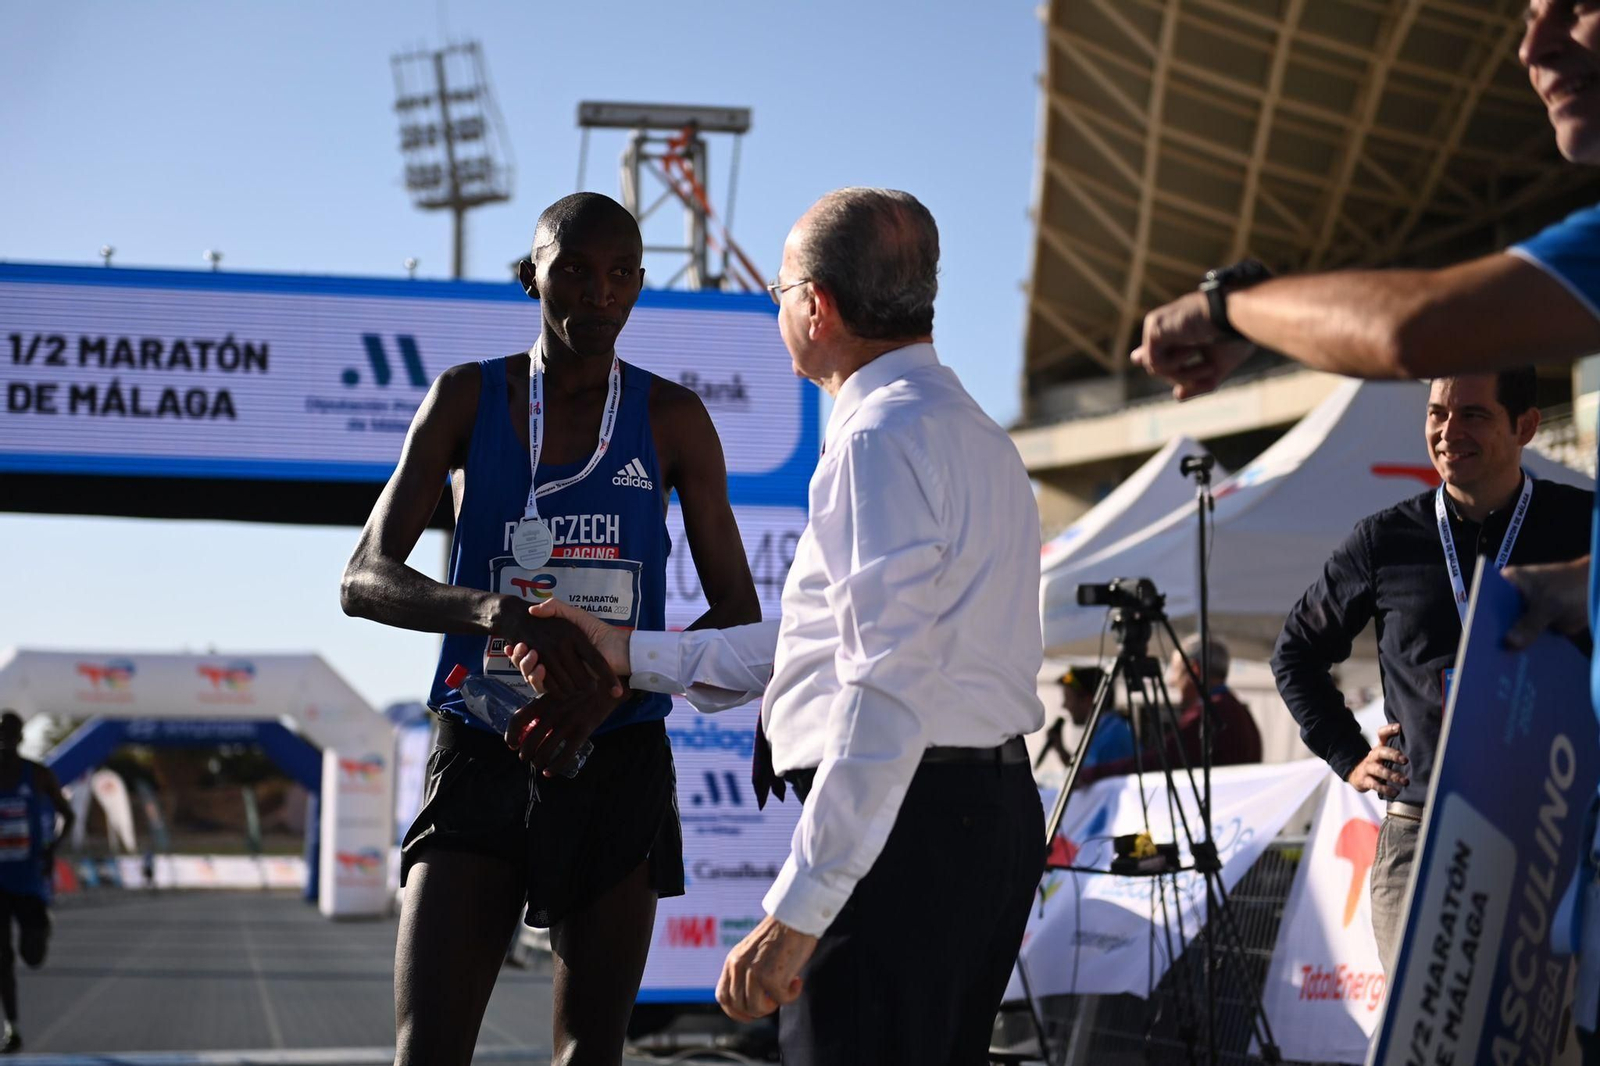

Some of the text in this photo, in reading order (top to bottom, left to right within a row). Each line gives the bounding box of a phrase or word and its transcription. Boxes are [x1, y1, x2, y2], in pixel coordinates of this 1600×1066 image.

[9, 333, 269, 373] 1/2 MARATÓN
[8, 377, 237, 419] DE MÁLAGA
[612, 476, 653, 490] adidas
[503, 514, 619, 551] RCZECH
[563, 547, 615, 559] RACING
[580, 604, 612, 613] MÁLAGA
[613, 605, 629, 614] 2022
[582, 595, 619, 603] MARATÓN
[1492, 733, 1576, 1066] ASCULINO
[1420, 839, 1472, 1017] MARATÓN
[1442, 891, 1489, 1042] MÁLAGA
[1526, 959, 1563, 1066] UEBA
